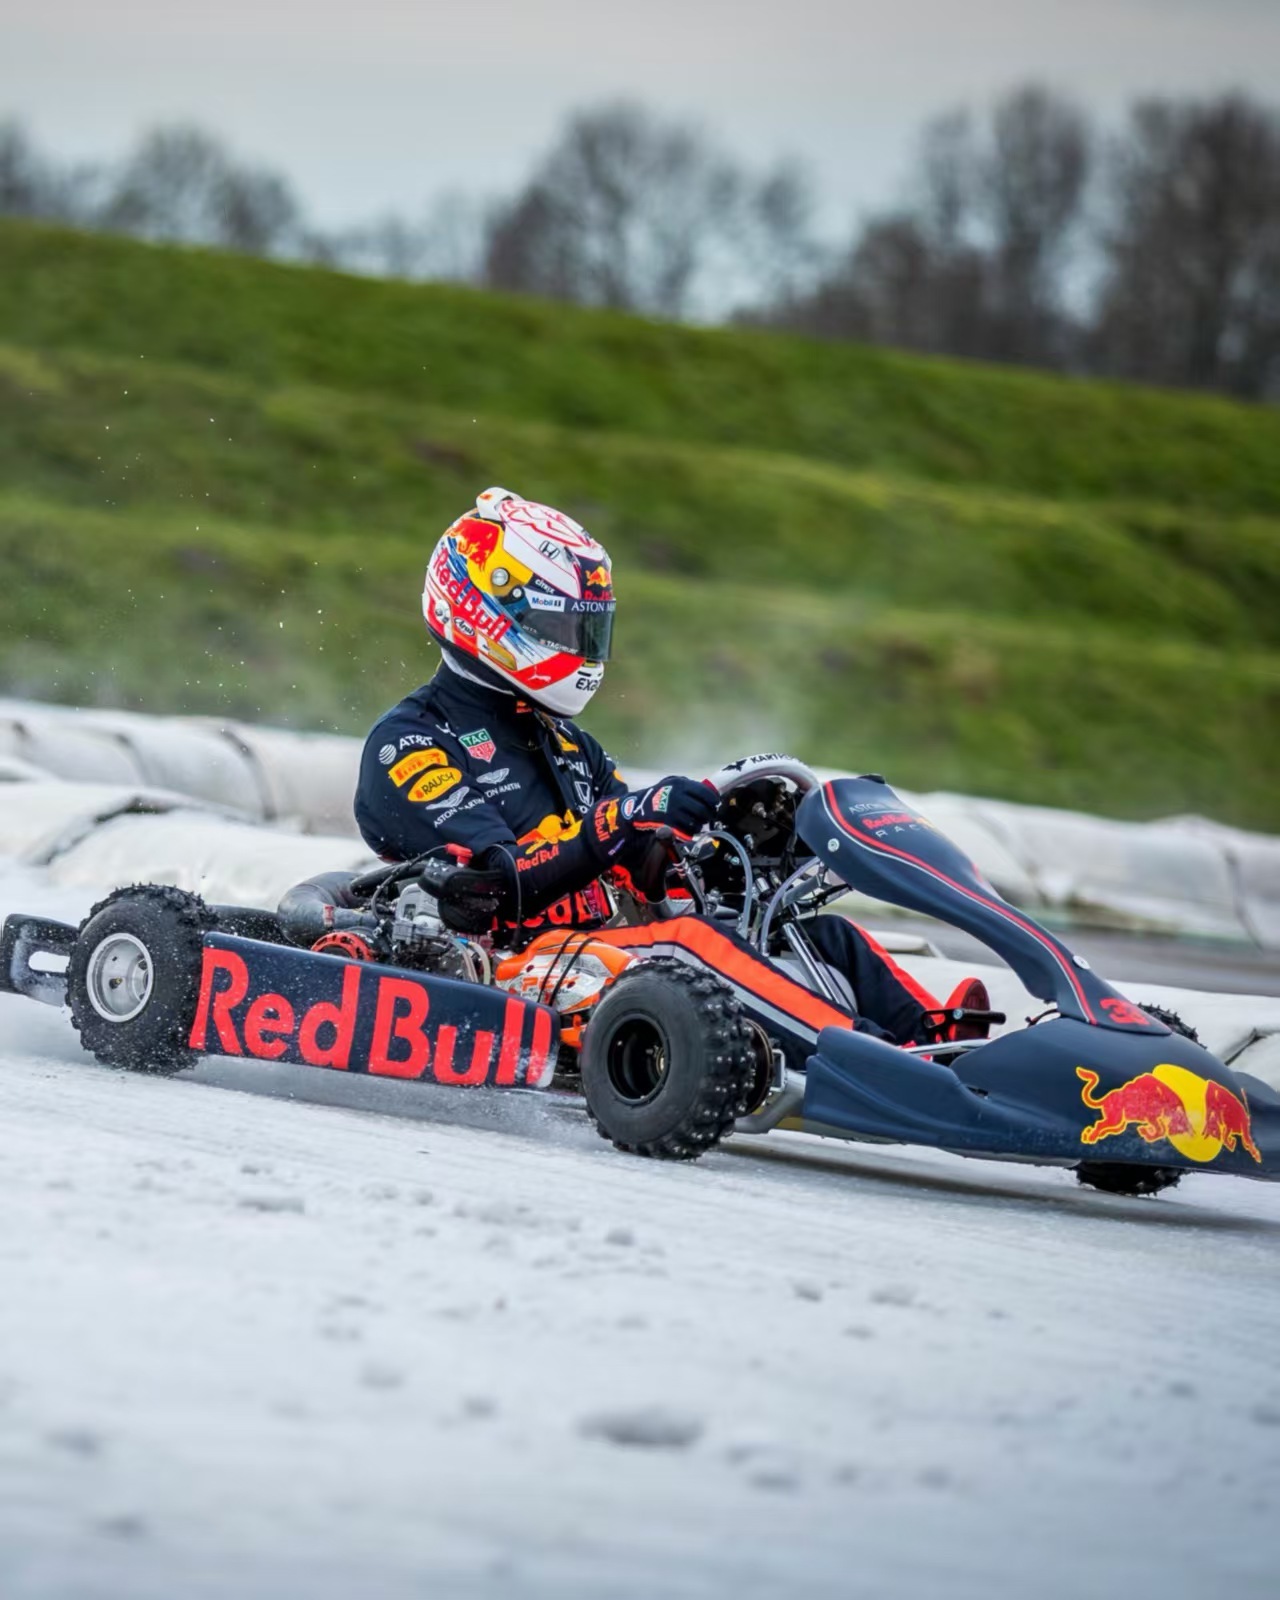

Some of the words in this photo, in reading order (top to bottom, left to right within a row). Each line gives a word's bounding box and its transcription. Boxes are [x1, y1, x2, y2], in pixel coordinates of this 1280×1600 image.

[532, 597, 553, 606] Mobil
[571, 602, 604, 612] ASTON
[400, 735, 433, 750] AT&T
[464, 732, 488, 746] TAG
[421, 772, 456, 795] RAUCH
[433, 807, 457, 829] ASTON
